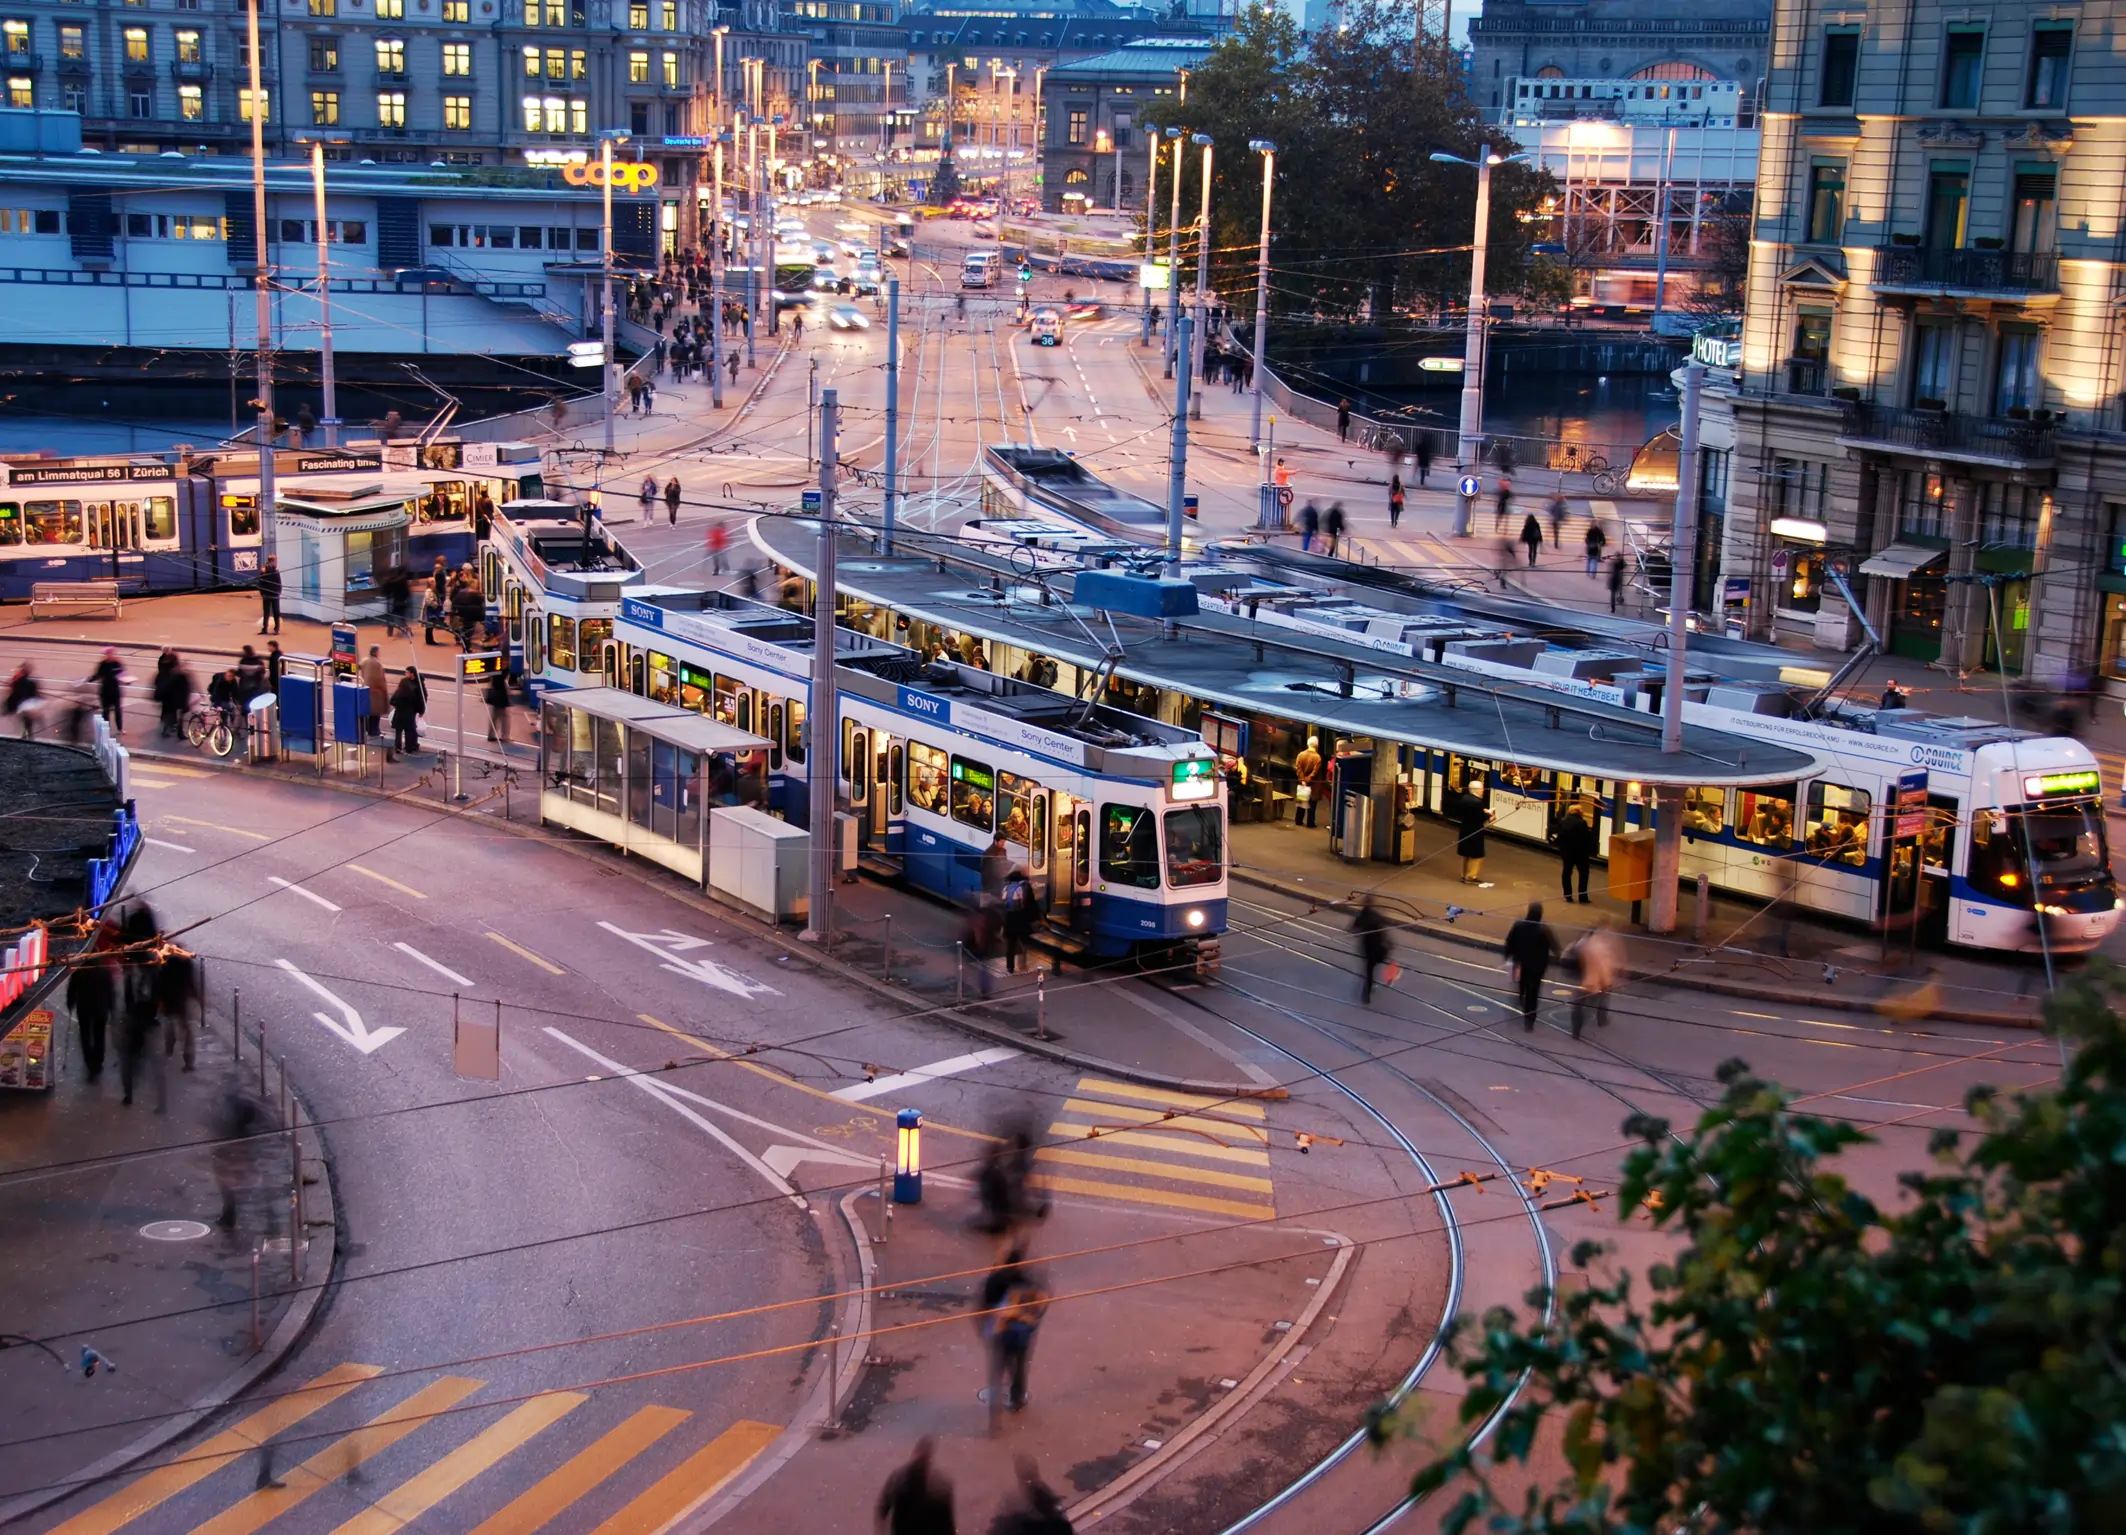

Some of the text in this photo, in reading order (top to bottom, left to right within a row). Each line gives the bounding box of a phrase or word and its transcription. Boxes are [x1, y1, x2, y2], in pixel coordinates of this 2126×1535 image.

[564, 162, 658, 195] coop
[1041, 336, 1054, 346] 36
[1697, 337, 1728, 366] HOTEL
[302, 457, 355, 471] Fascinating
[466, 453, 495, 464] CIMIER
[17, 473, 35, 482] am
[38, 468, 104, 483] Limmatquai
[107, 468, 121, 479] 56
[133, 466, 169, 479] Zürich
[631, 604, 655, 621] SONY
[747, 642, 787, 662] Sony Center
[907, 693, 939, 714] SONY
[1578, 687, 1620, 703] HEARTBEAT
[1021, 728, 1075, 754] Sony Center
